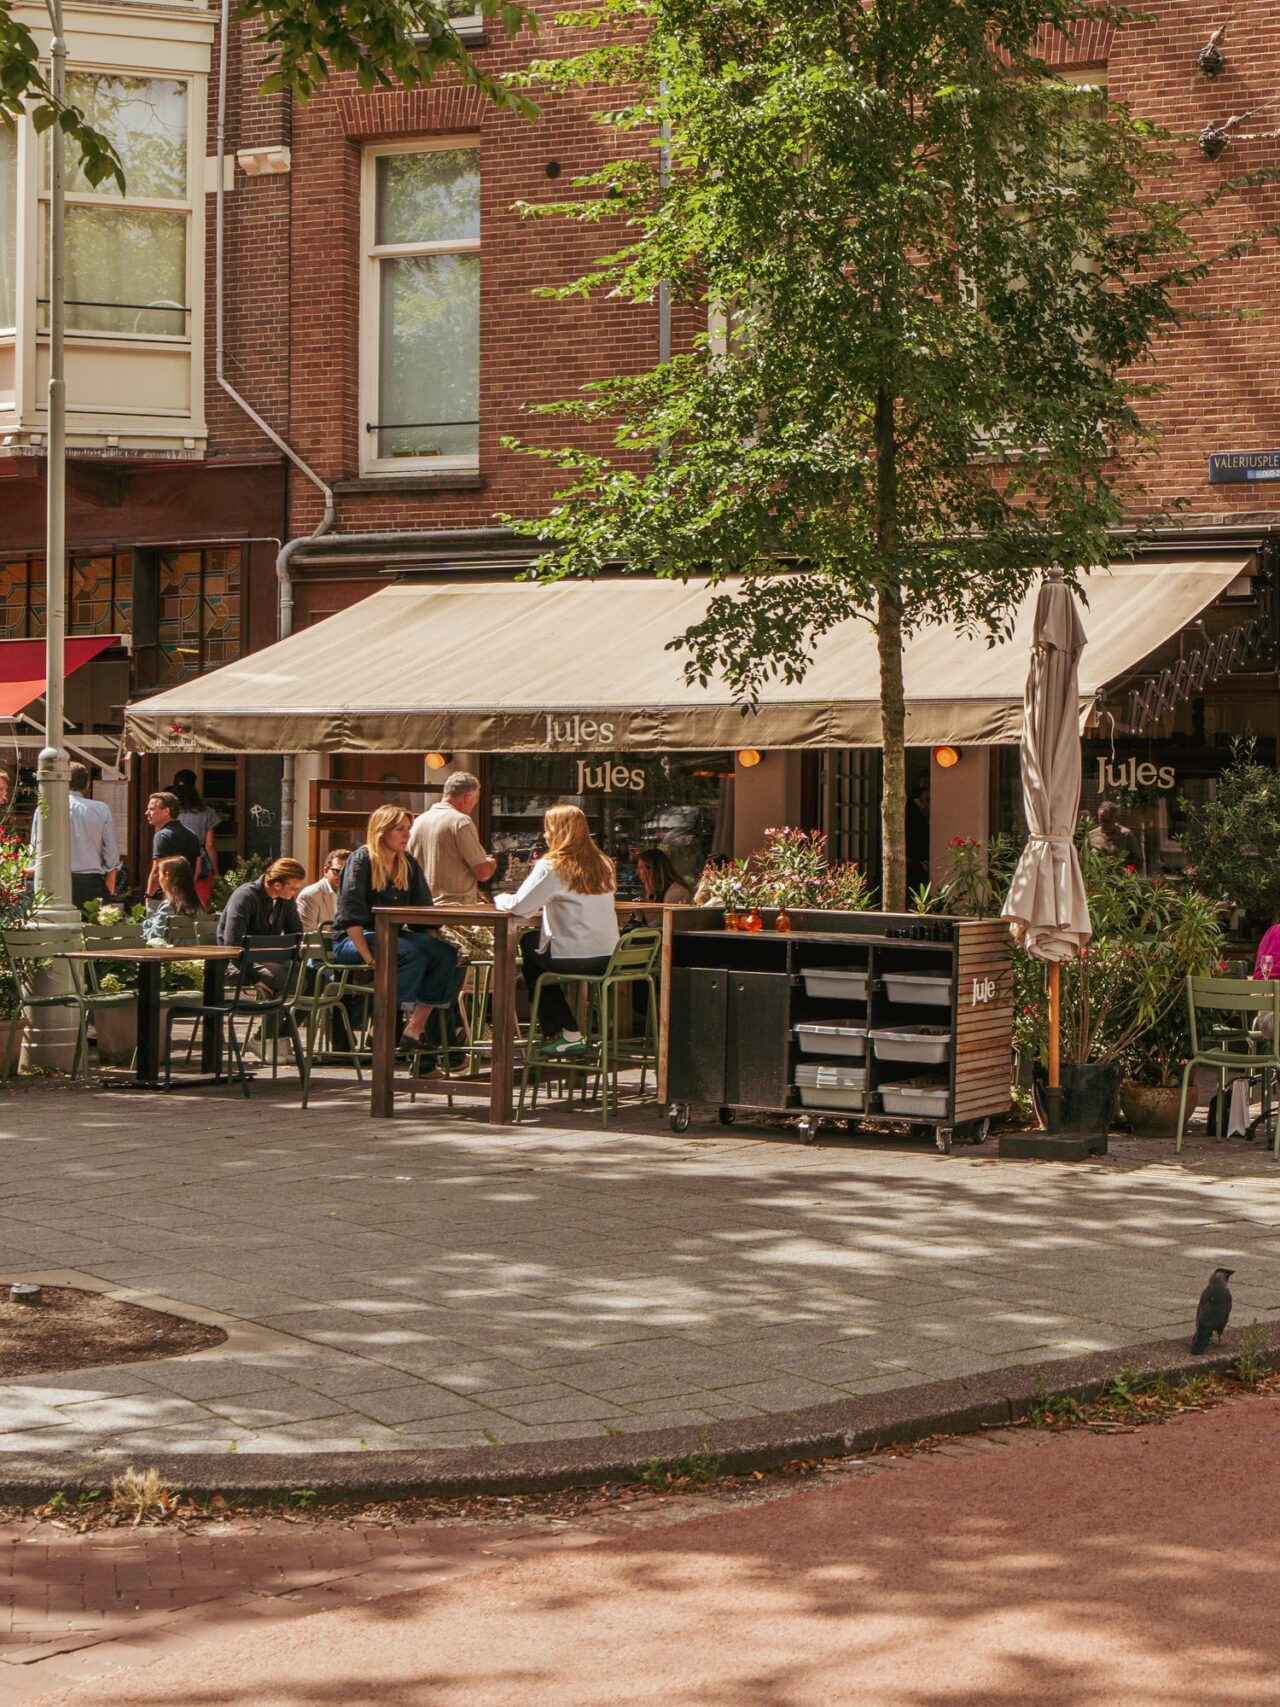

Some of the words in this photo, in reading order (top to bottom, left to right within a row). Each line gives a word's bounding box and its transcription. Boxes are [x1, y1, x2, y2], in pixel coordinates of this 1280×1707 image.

[544, 713, 614, 746] Jules
[576, 760, 645, 795] Jules
[1096, 756, 1176, 794] Jules
[972, 977, 996, 1007] Jule
